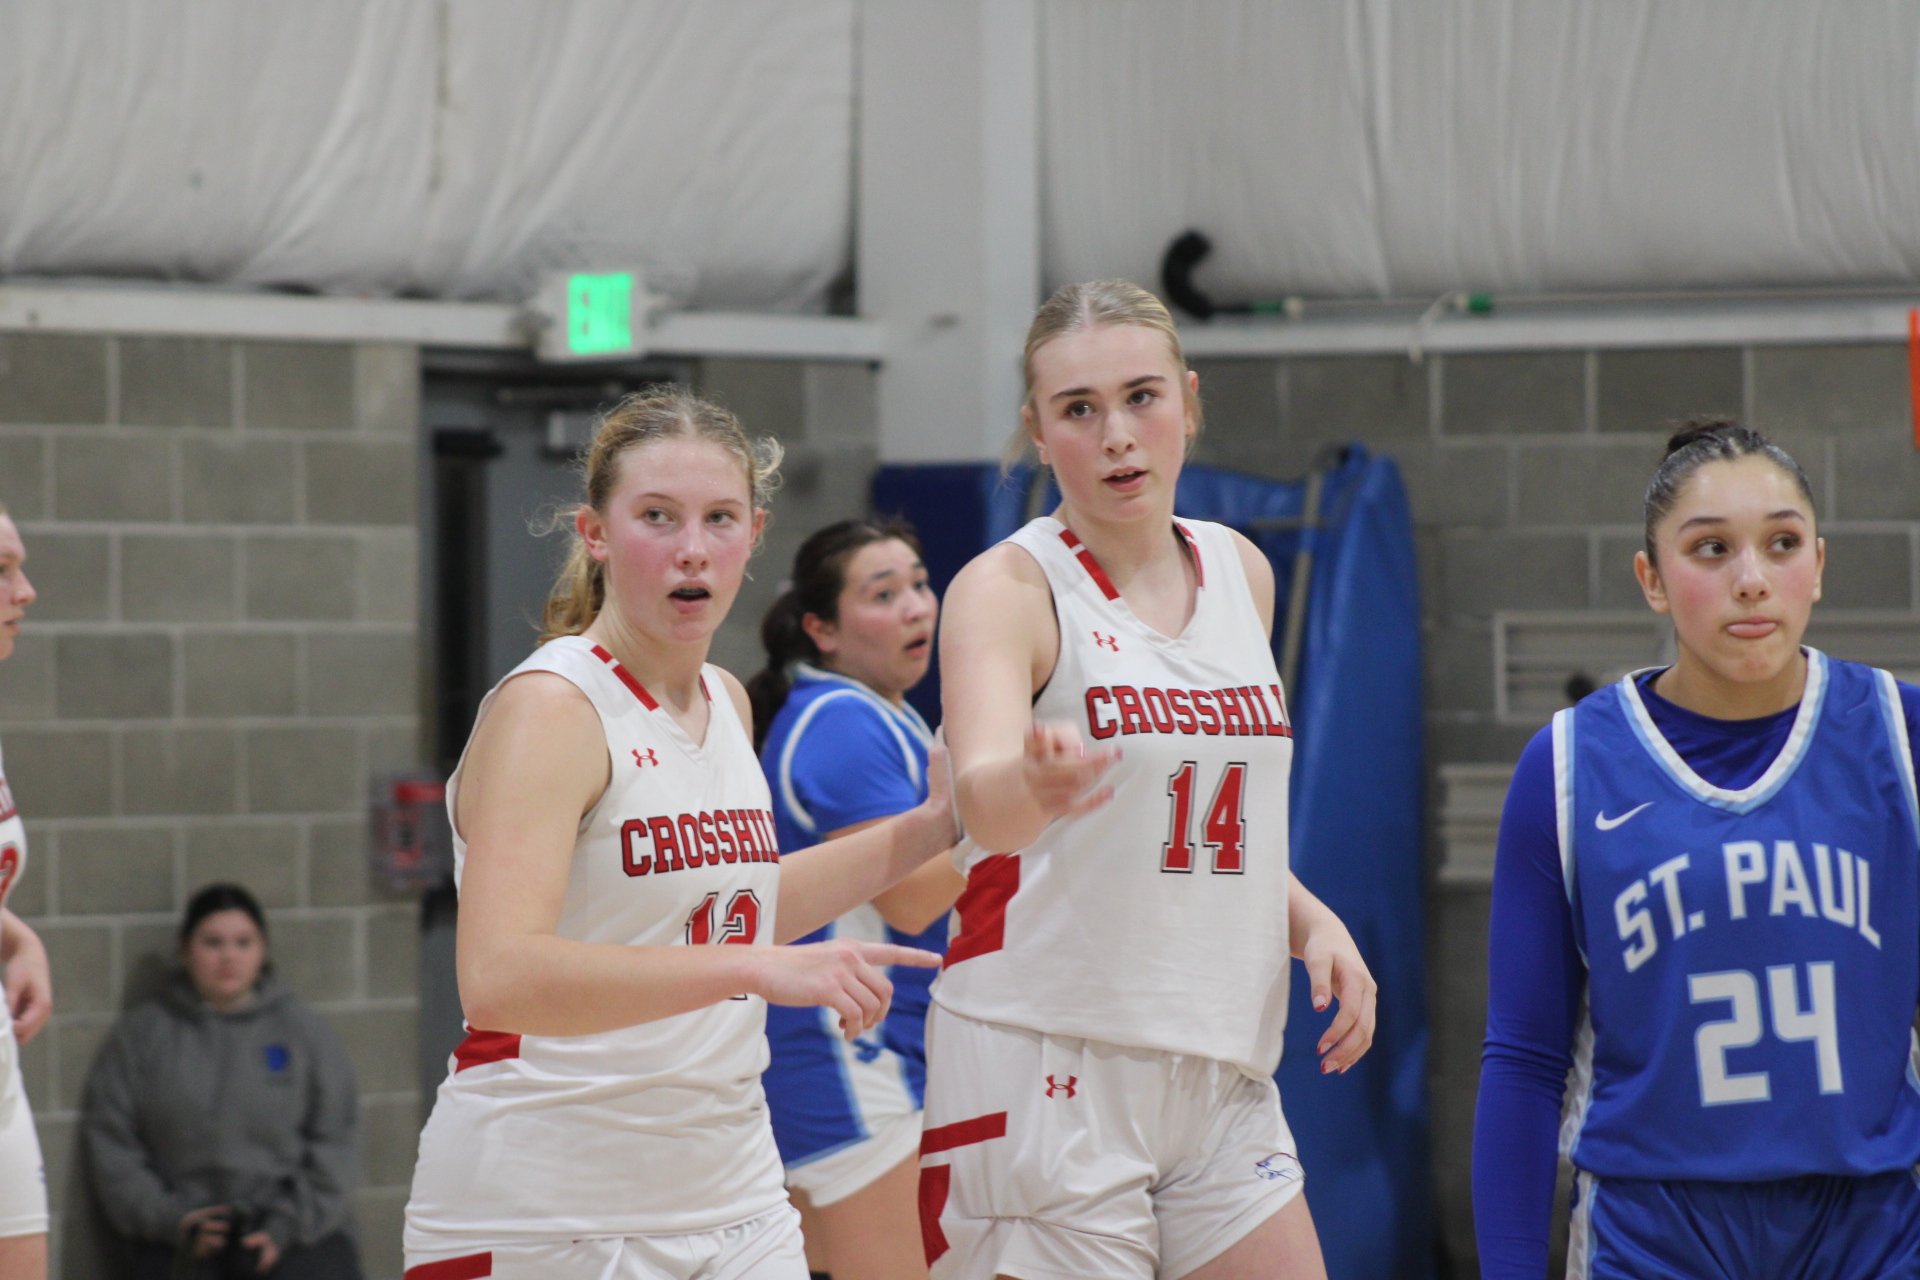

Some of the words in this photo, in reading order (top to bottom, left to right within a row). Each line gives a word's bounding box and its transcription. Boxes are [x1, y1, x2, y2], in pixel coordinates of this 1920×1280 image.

[1160, 760, 1247, 875] 14
[1613, 853, 1705, 973] ST.
[1722, 840, 1881, 950] PAUL
[1687, 961, 1844, 1107] 24
